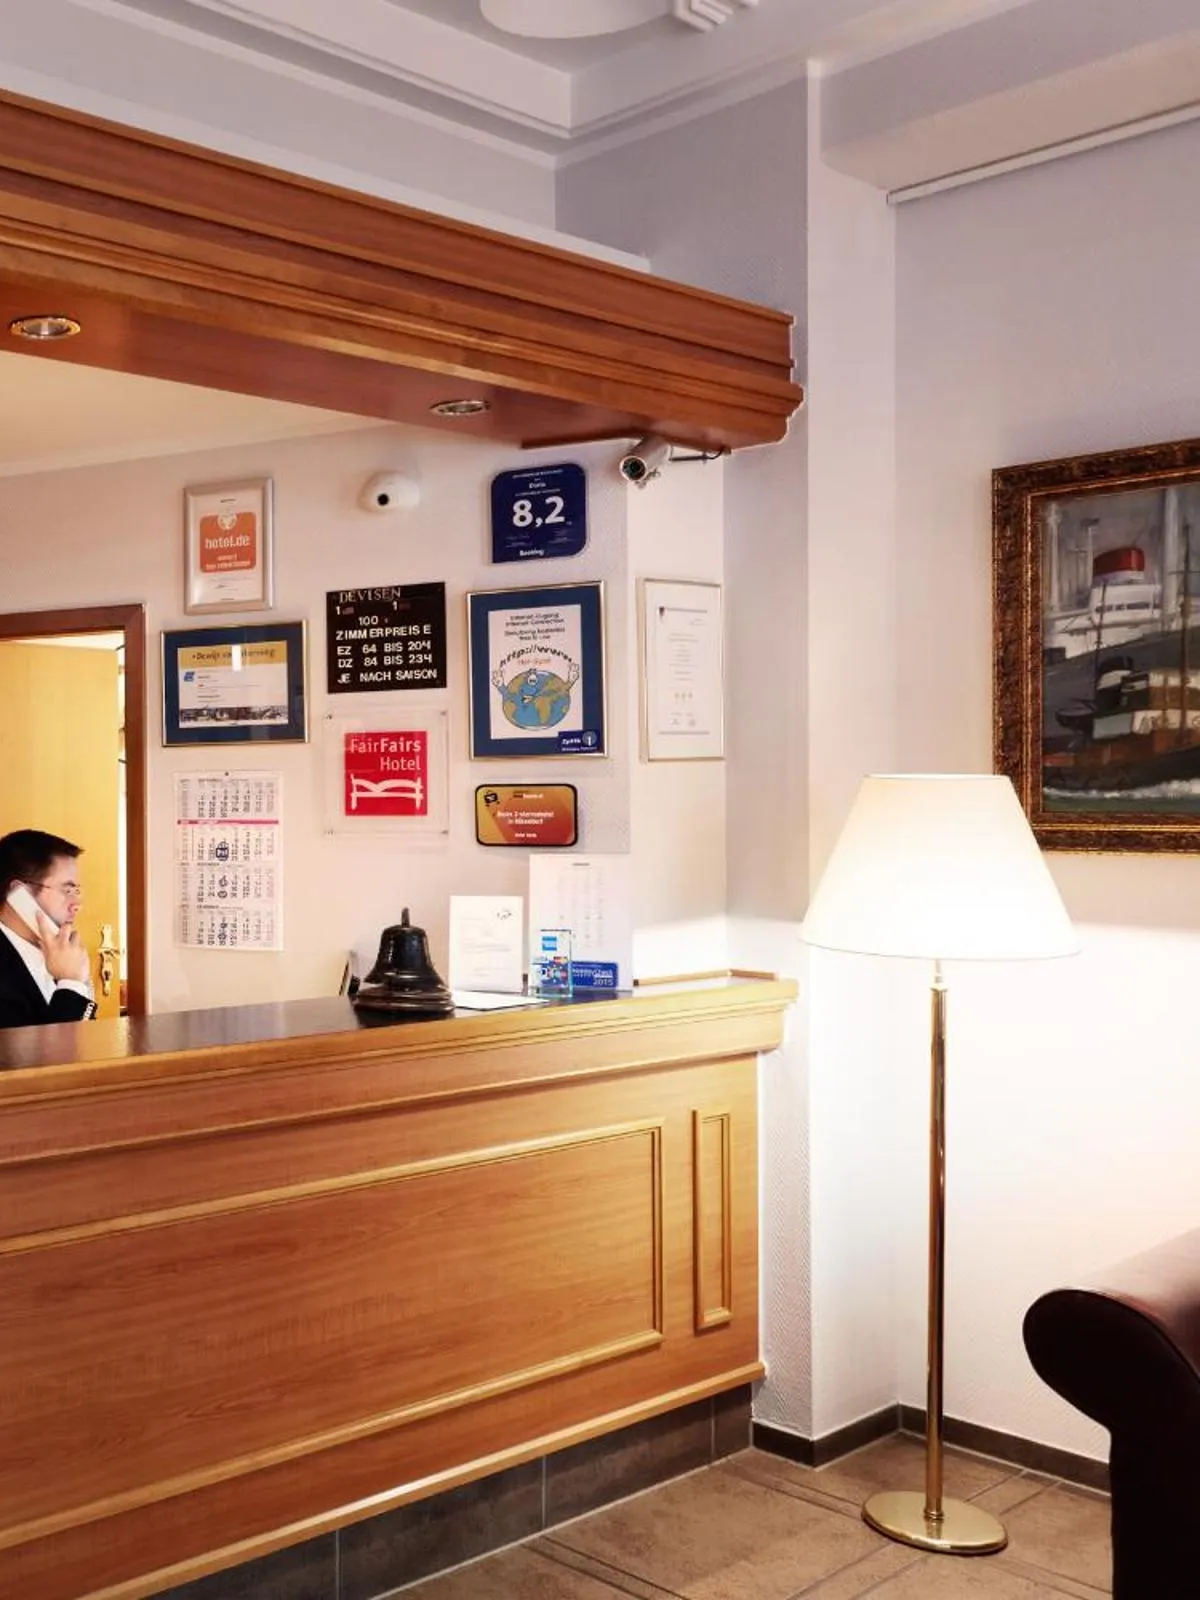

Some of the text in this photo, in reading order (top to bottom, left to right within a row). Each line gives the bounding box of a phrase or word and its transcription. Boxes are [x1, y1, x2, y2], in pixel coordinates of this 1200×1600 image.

[512, 495, 565, 528] 8,2
[204, 534, 250, 550] hotel.de
[340, 587, 401, 604] DEVISEN
[358, 615, 379, 626] 100
[336, 624, 432, 641] ZIMMERPREISE
[337, 640, 431, 656] EZ 64 BIS 204
[338, 653, 432, 669] DZ 84 BIS 234
[337, 668, 437, 684] JE NACH SAISON
[350, 736, 422, 753] FairFairs
[380, 755, 421, 771] Hotel
